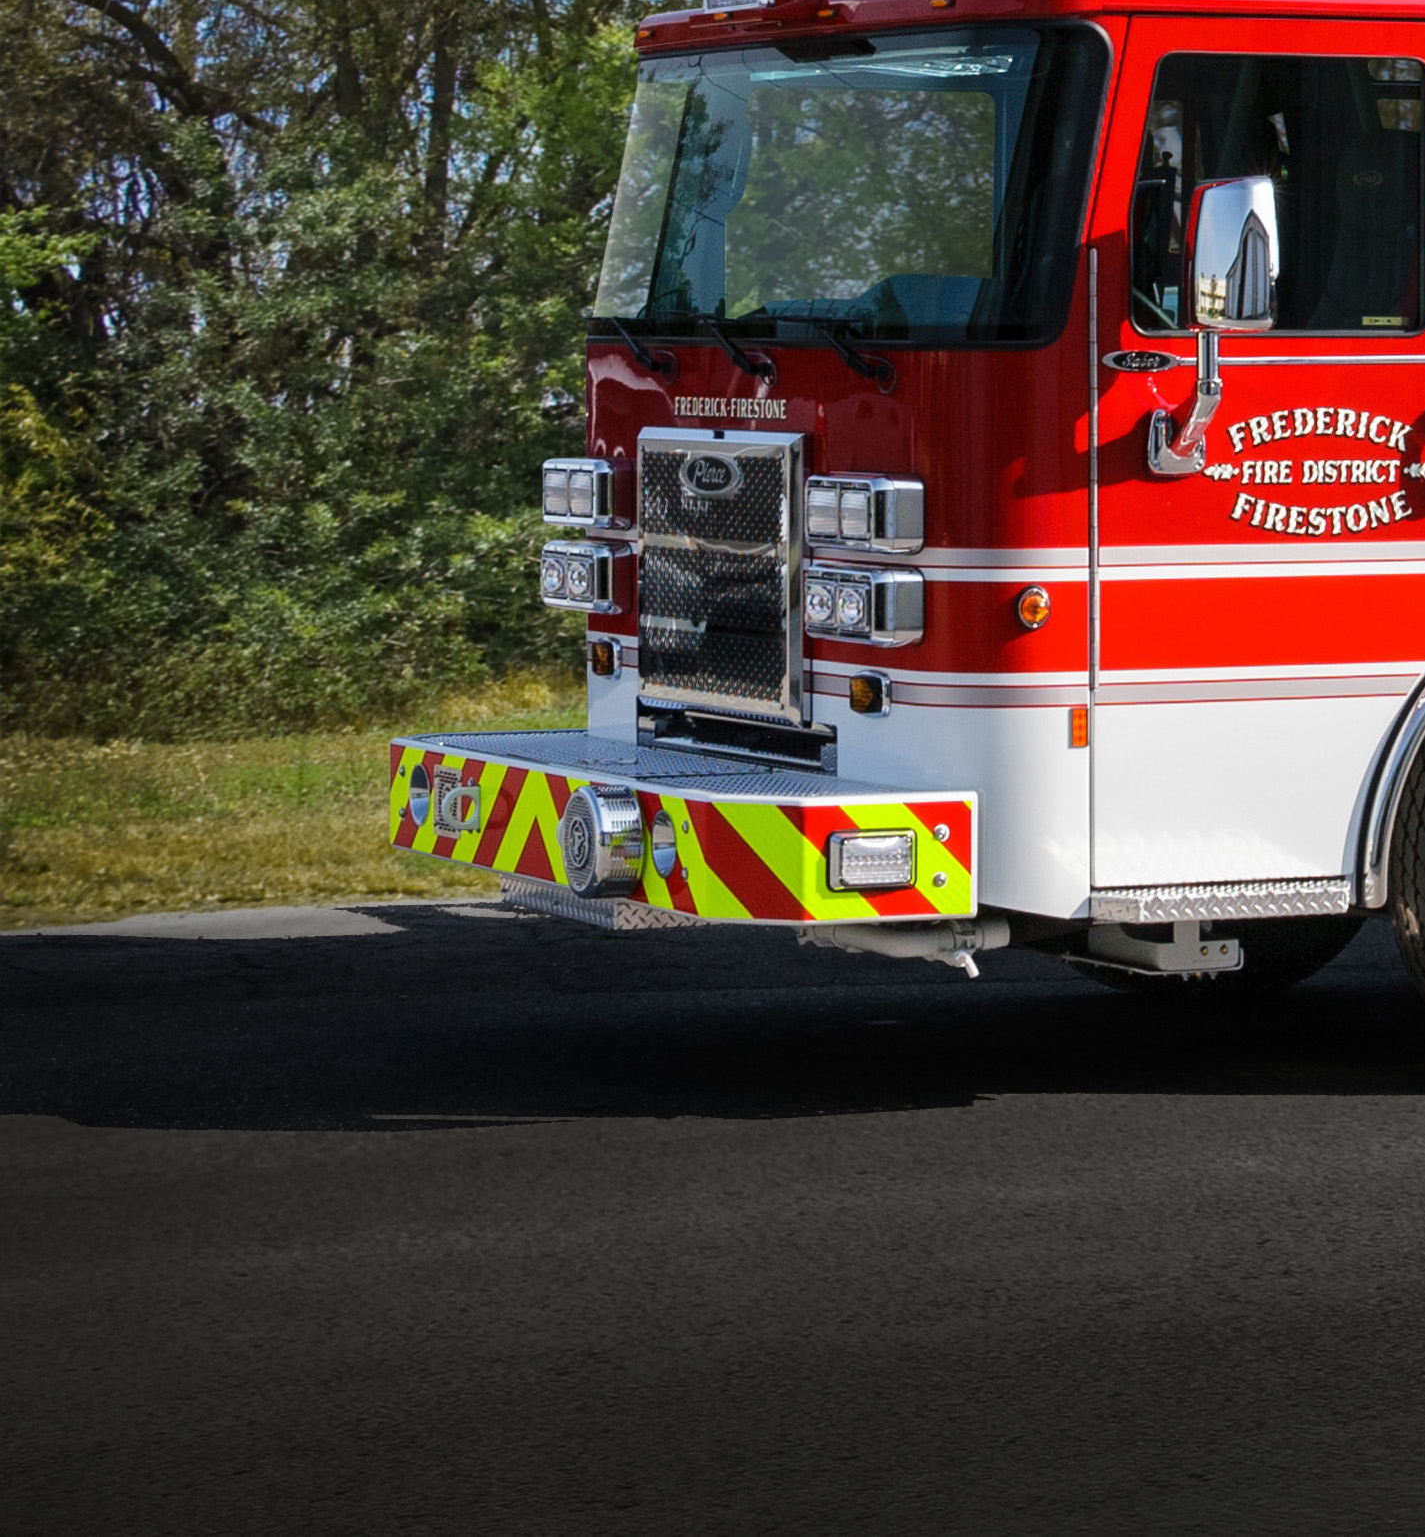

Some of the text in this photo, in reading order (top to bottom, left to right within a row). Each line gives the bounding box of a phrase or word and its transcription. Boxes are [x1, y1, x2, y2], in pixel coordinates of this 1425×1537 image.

[1227, 407, 1414, 454] FREDERICK
[692, 459, 727, 486] Pierce
[1241, 459, 1401, 485] FIRE DISTRICT
[1231, 490, 1413, 536] FIRESTONE
